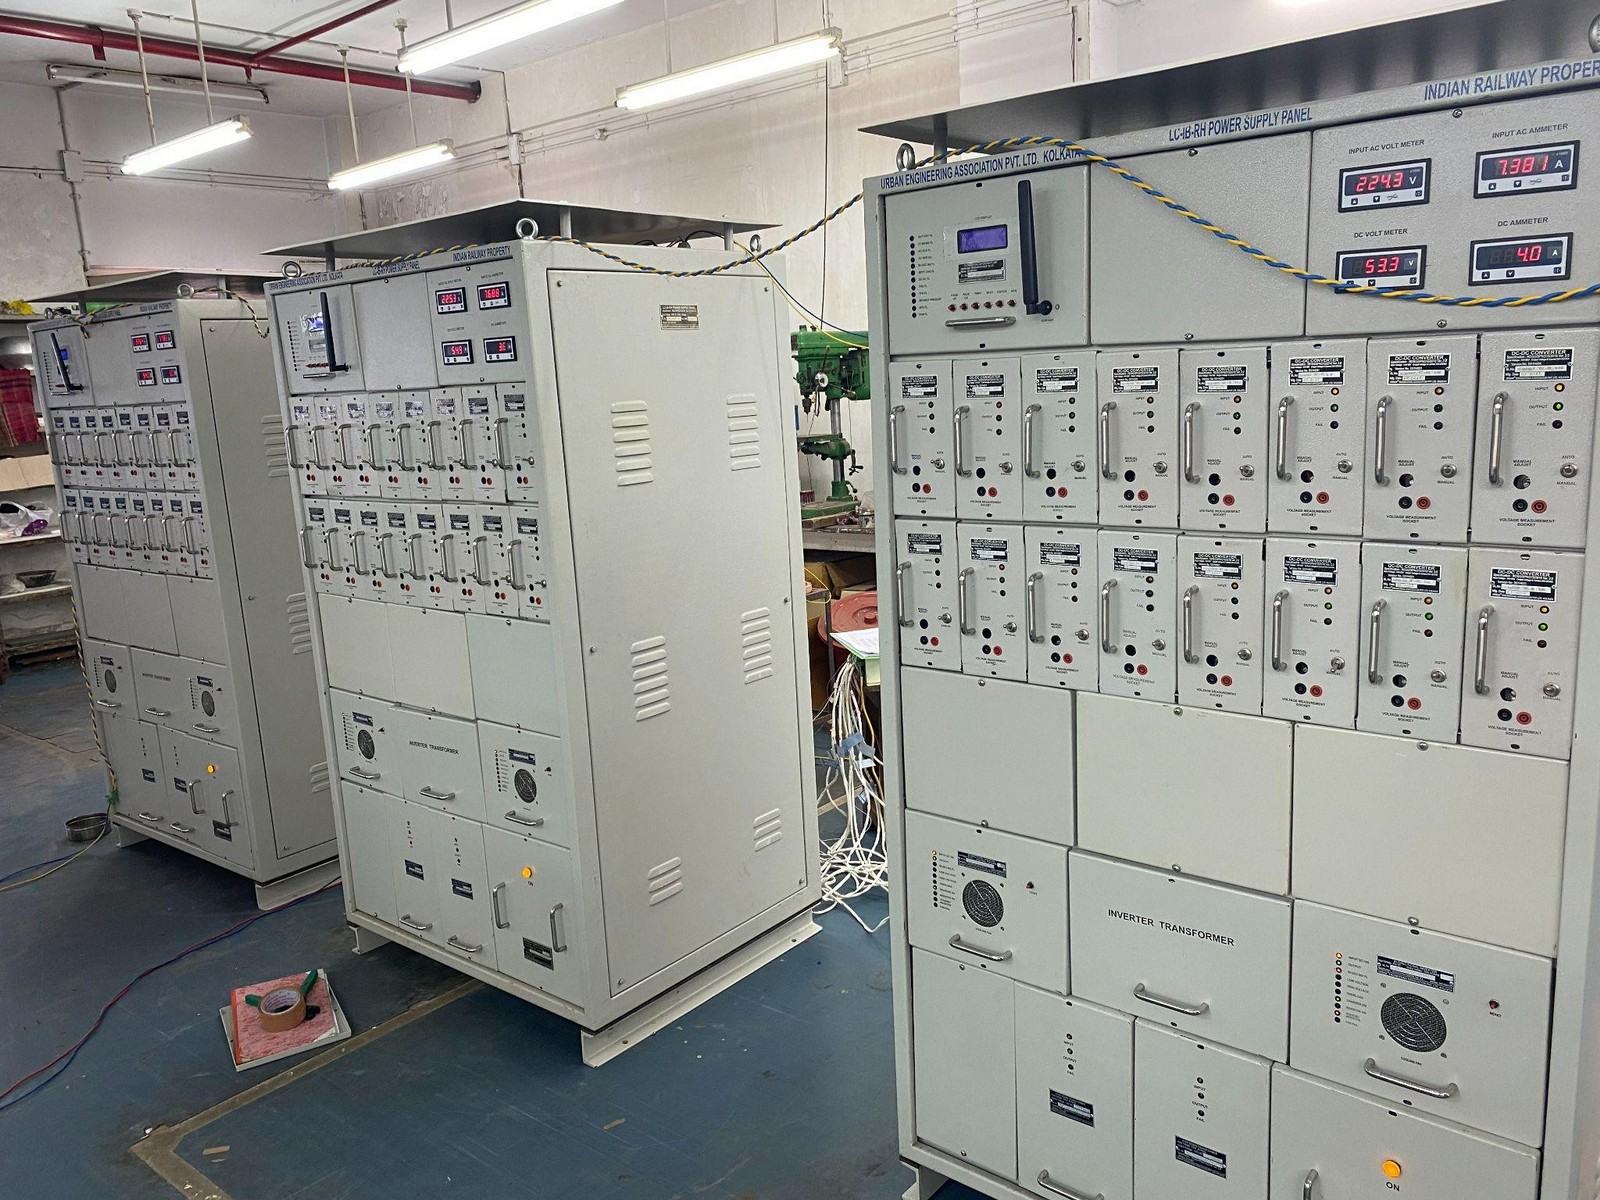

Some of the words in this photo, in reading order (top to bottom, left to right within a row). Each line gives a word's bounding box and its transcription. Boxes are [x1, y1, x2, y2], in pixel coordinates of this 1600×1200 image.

[1424, 78, 1470, 100] INDIAN
[1474, 68, 1538, 94] RAILWAY
[1208, 117, 1241, 136] POWER
[1244, 111, 1279, 130] SUPPLY
[1282, 107, 1313, 125] PANEL
[1492, 130, 1513, 138] INPUT
[1529, 123, 1568, 134] AMMETER
[1381, 142, 1399, 150] VOLT
[1401, 139, 1425, 148] METER
[881, 173, 903, 189] URBAN
[905, 168, 953, 184] ENGINEERING
[954, 159, 1003, 177] ASSOCIATION
[1005, 156, 1021, 169] PVT.
[1023, 153, 1039, 165] LTD.
[1498, 154, 1549, 175] 7.381
[1555, 160, 1564, 168] A
[1356, 172, 1404, 192] 224.3
[1409, 176, 1416, 185] V
[1510, 217, 1548, 226] AMMETER
[1384, 228, 1408, 236] METER
[1516, 245, 1542, 262] 4.0
[1365, 256, 1399, 273] 53.3
[1108, 909, 1154, 926] INVERTER
[1159, 921, 1234, 946] TRANSFORMER
[1386, 1182, 1400, 1192] ON
